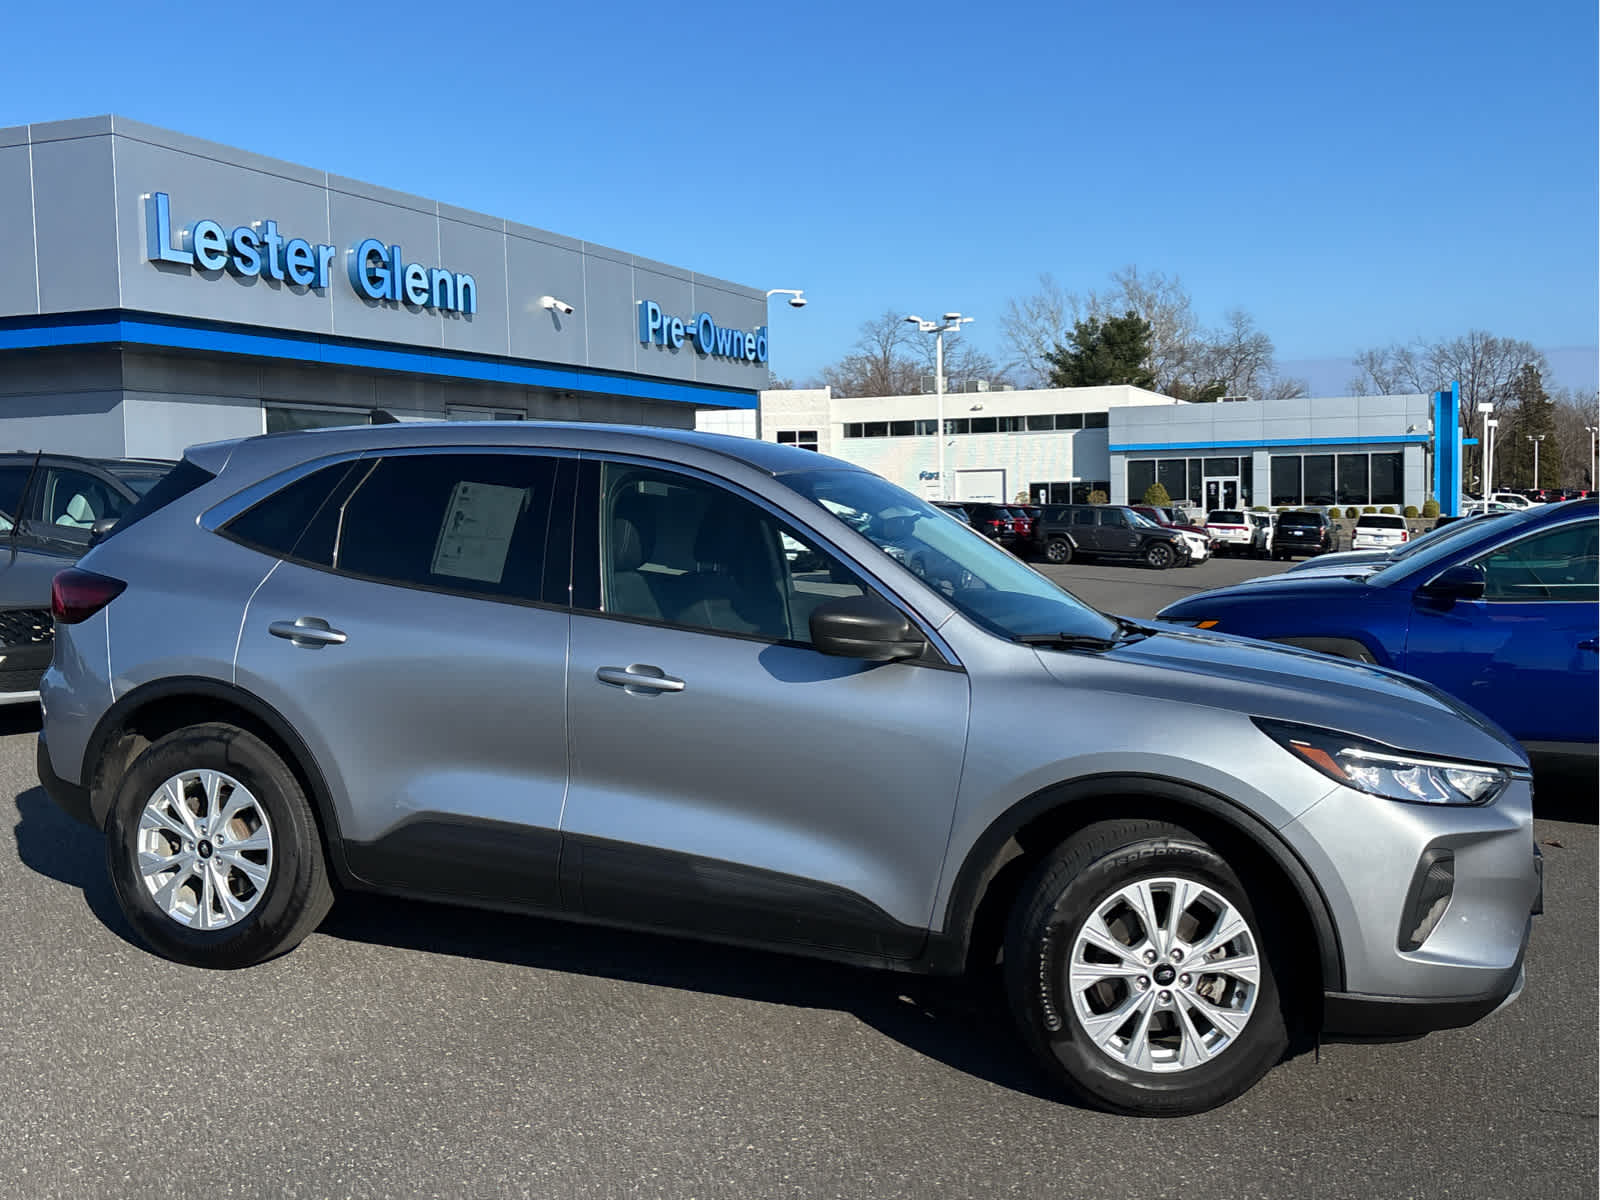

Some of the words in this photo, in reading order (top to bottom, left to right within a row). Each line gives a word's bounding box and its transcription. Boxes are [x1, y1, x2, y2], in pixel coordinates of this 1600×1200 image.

[148, 192, 336, 289] Lester
[349, 238, 477, 314] Glenn
[640, 300, 768, 362] Pre-Owned
